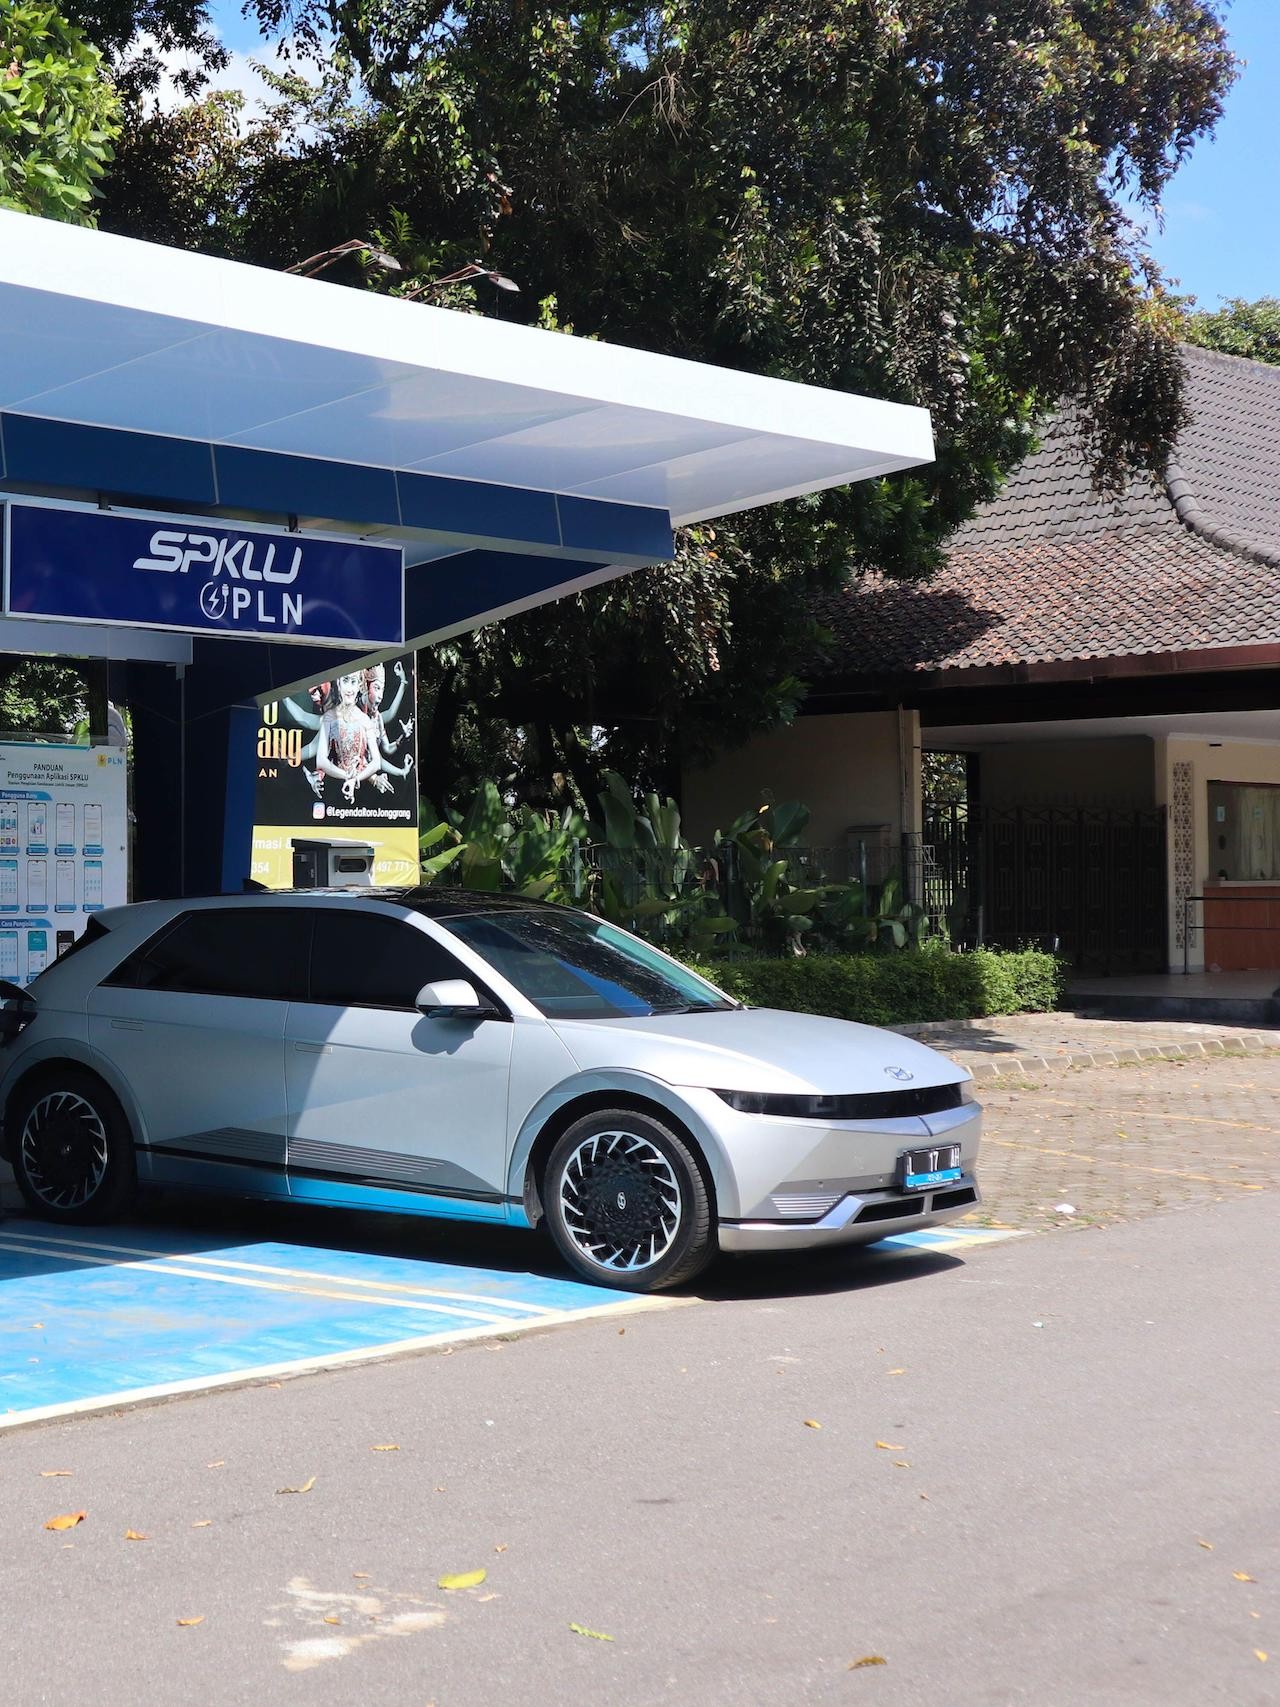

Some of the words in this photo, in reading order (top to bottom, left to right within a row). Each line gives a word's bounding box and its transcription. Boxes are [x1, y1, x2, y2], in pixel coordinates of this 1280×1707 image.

[132, 530, 303, 585] SPKLU
[232, 586, 303, 626] PLN
[33, 763, 64, 772] PANDUAN
[107, 757, 123, 765] PLN
[7, 771, 45, 781] Penggunaan
[46, 772, 69, 781] Aplikasi
[70, 773, 89, 781] SPKLU
[929, 1151, 939, 1172] 17
